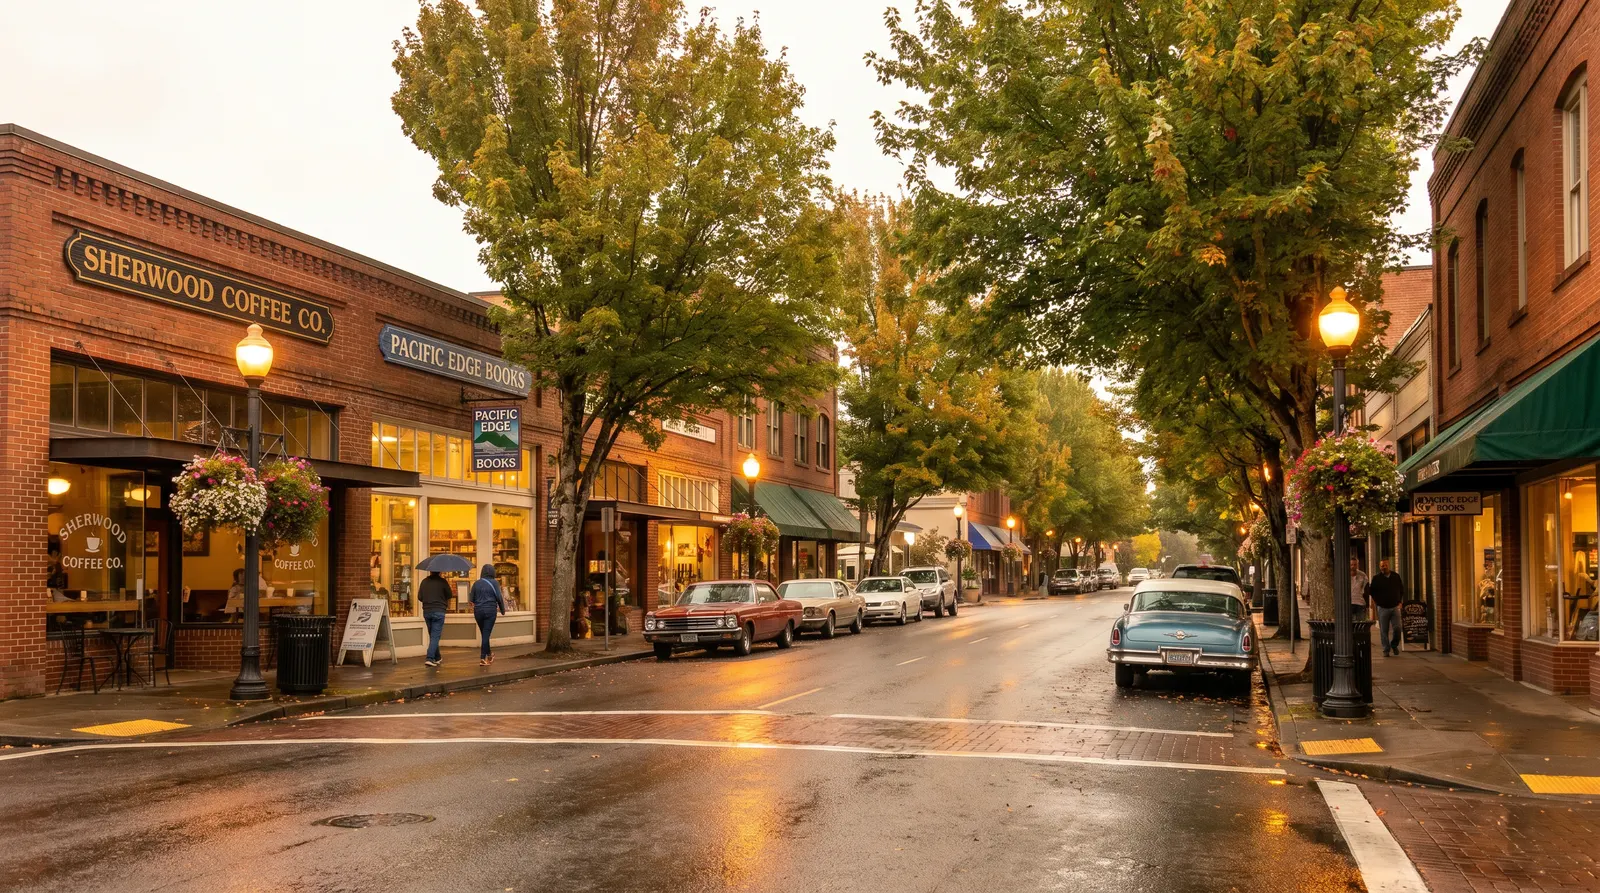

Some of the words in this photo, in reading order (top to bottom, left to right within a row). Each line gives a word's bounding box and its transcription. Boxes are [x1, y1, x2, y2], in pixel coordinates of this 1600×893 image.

[84, 245, 214, 302] SHERWOOD
[222, 285, 291, 325] COFFEE
[298, 308, 326, 333] CO.
[391, 334, 444, 367] PACIFIC
[448, 351, 482, 377] EDGE
[485, 362, 525, 389] BOOKS
[475, 409, 518, 421] PACIFIC
[481, 421, 511, 432] EDGE
[476, 457, 516, 469] BOOKS
[1437, 504, 1465, 512] BOOKS
[59, 513, 127, 544] SHERWOOD
[62, 555, 103, 569] COFFEE
[106, 557, 124, 569] CO.
[274, 558, 302, 570] COFFEE
[303, 559, 316, 569] CO.
